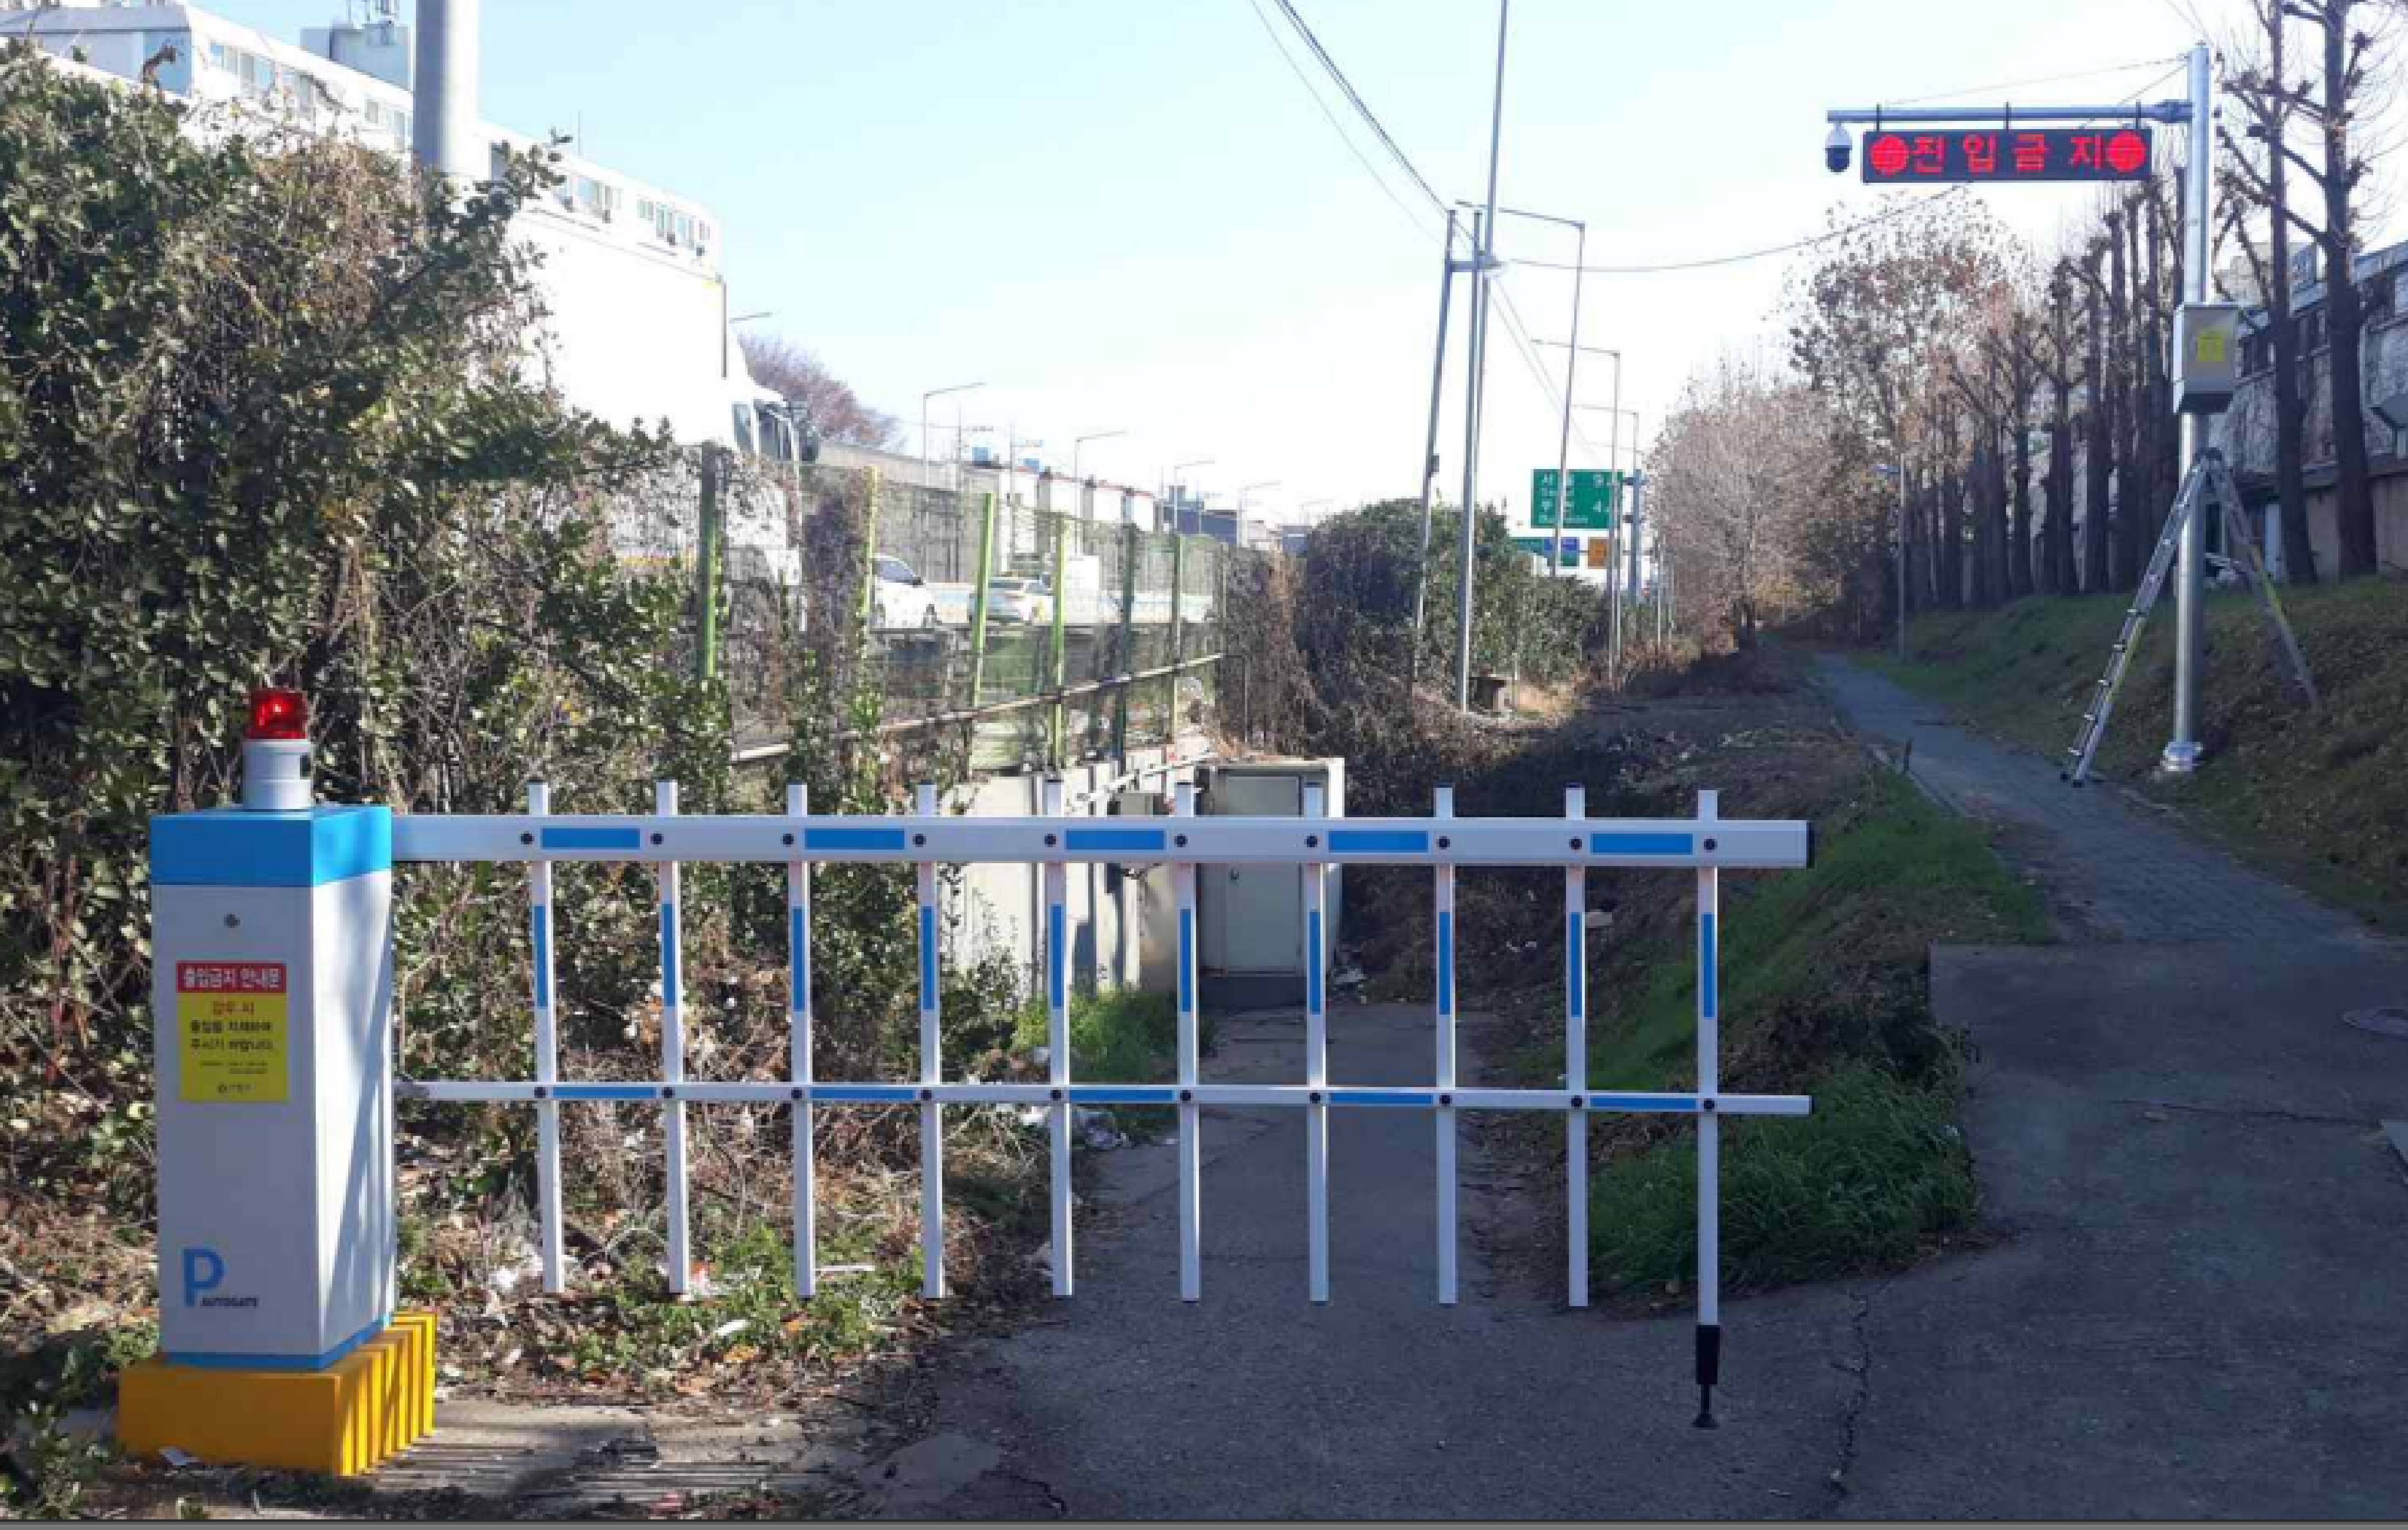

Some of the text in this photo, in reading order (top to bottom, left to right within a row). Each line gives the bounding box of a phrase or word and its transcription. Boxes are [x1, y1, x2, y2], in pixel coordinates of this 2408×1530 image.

[184, 968, 281, 988] 출입금지 안내문
[184, 1248, 222, 1308] P
